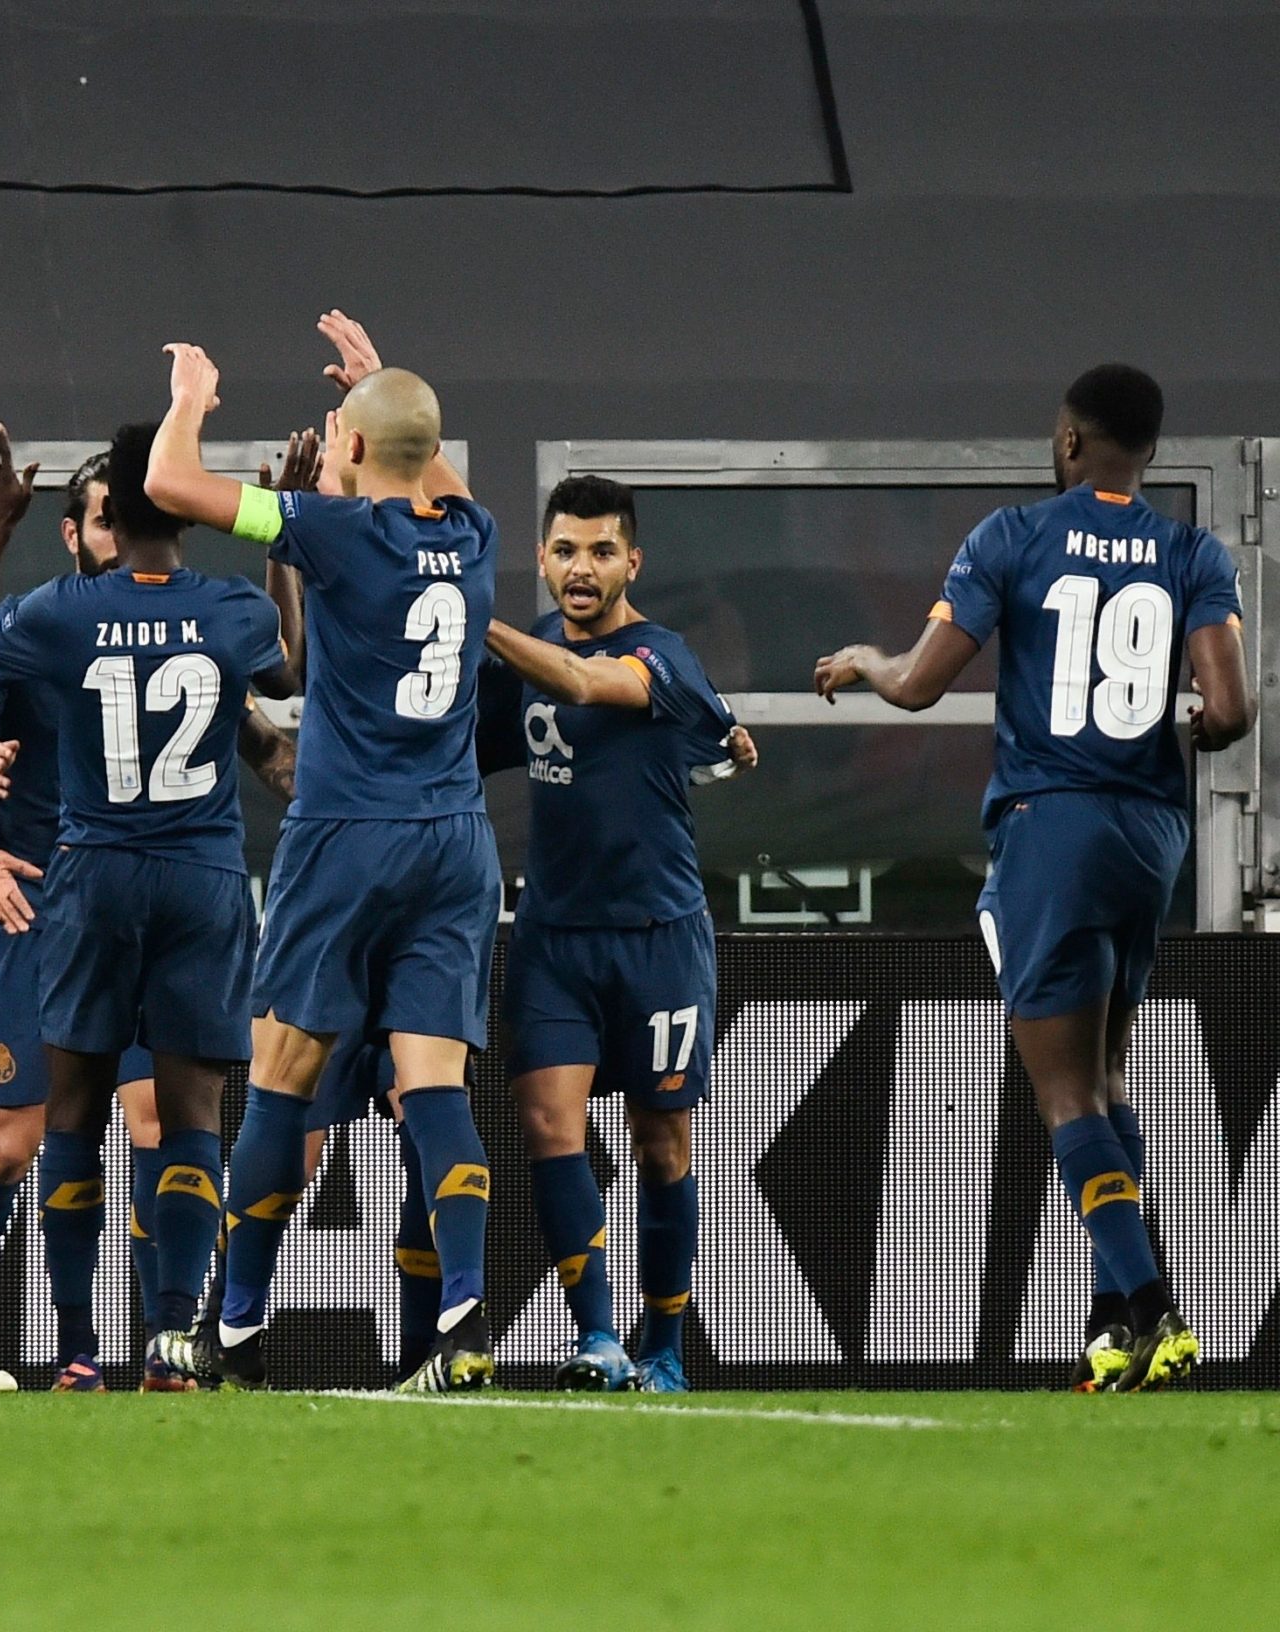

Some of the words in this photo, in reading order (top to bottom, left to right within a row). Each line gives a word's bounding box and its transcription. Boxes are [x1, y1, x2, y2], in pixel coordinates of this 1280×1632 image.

[417, 550, 462, 576] PEPE
[1066, 529, 1157, 564] MBEMBA
[95, 622, 167, 647] ZAIDU
[181, 619, 204, 643] M.
[395, 581, 467, 719] 3
[1042, 574, 1173, 740] 19
[82, 653, 221, 803] 12
[648, 1005, 698, 1072] 17
